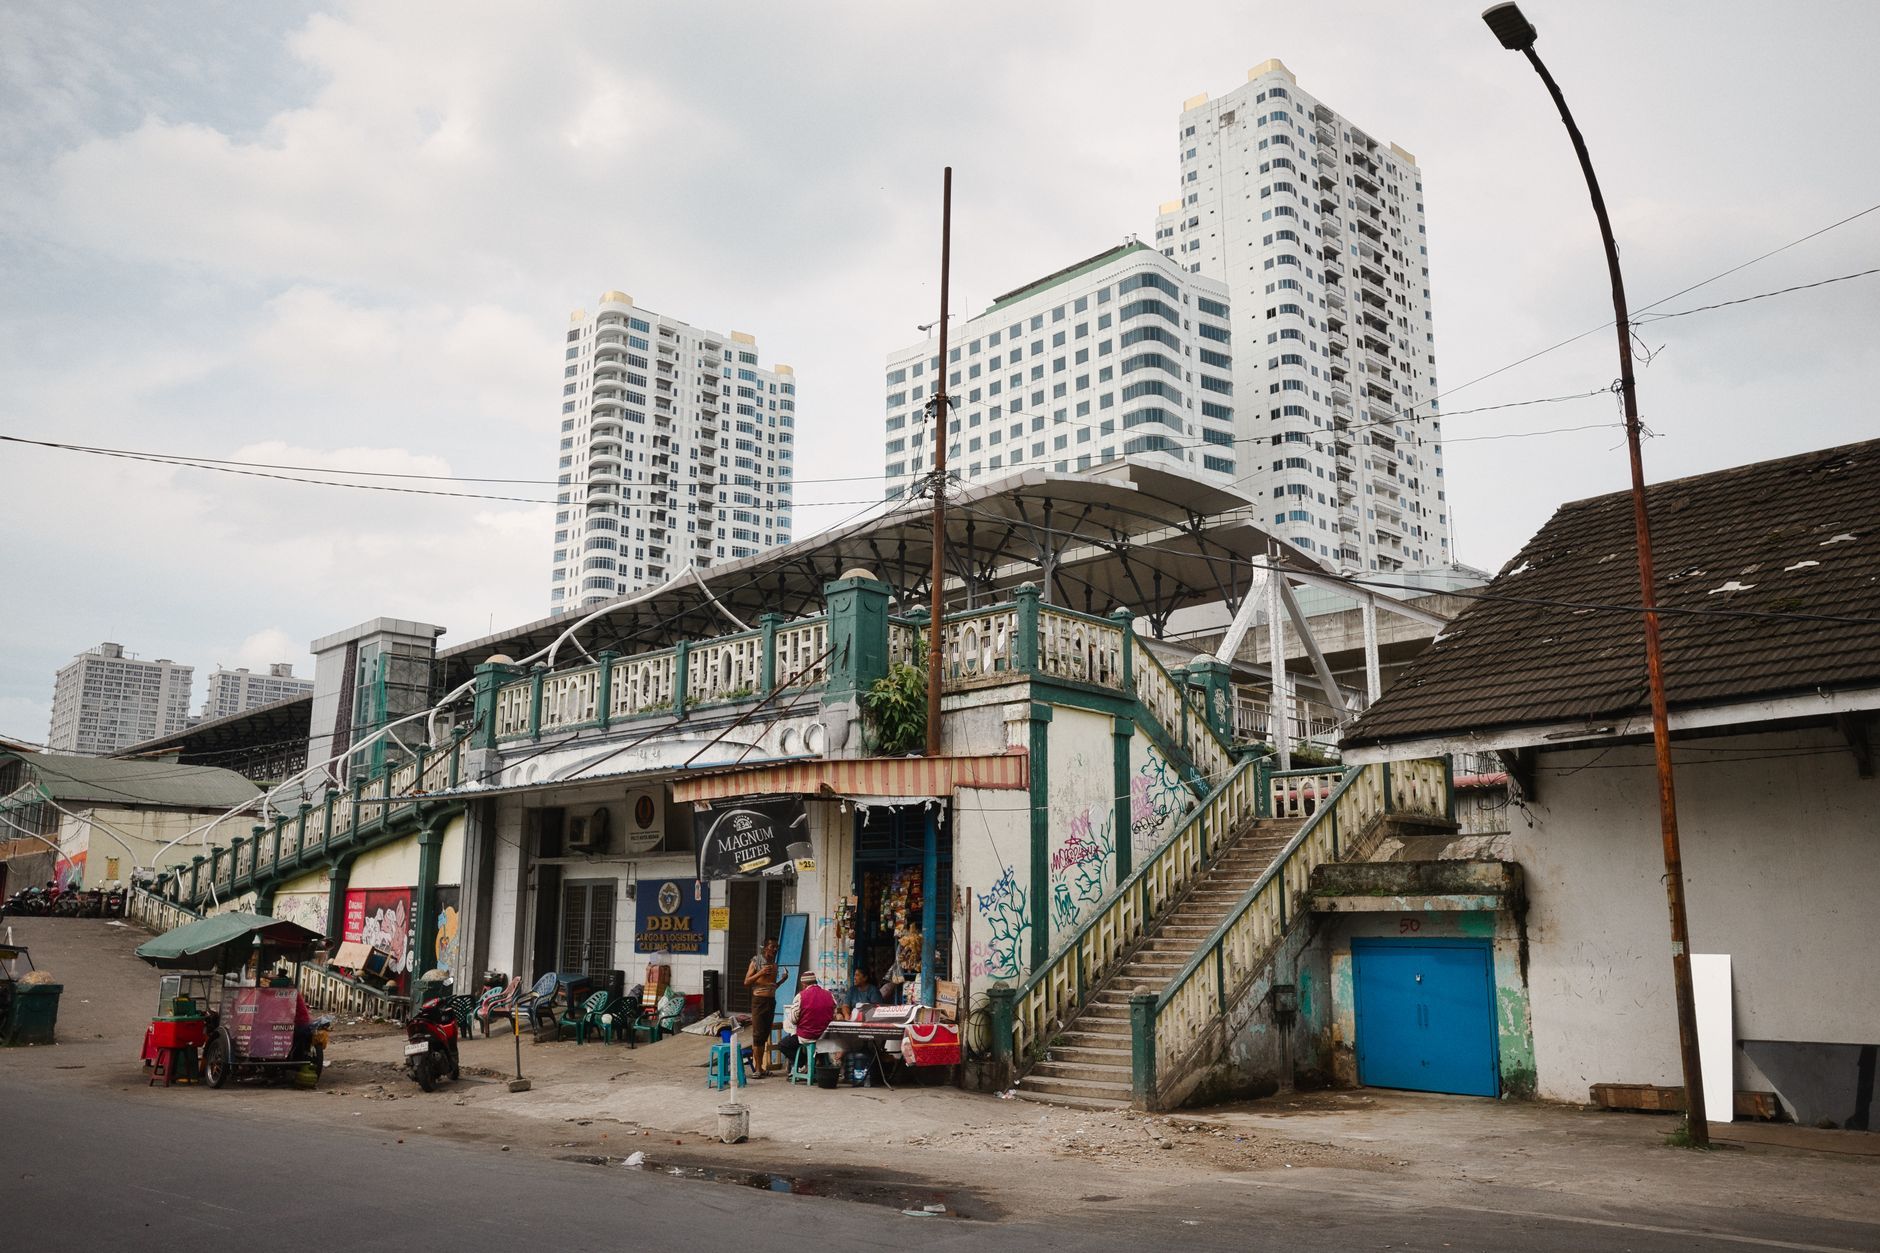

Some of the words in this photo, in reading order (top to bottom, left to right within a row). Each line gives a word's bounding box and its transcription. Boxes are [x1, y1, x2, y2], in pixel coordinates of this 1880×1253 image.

[718, 826, 774, 853] MAGNUM
[734, 843, 771, 863] FILTER
[647, 916, 690, 930] DBM
[1400, 918, 1420, 934] 50
[636, 933, 658, 942] CARGO
[665, 933, 704, 942] LOGISTICS
[672, 943, 698, 951] MEDAN
